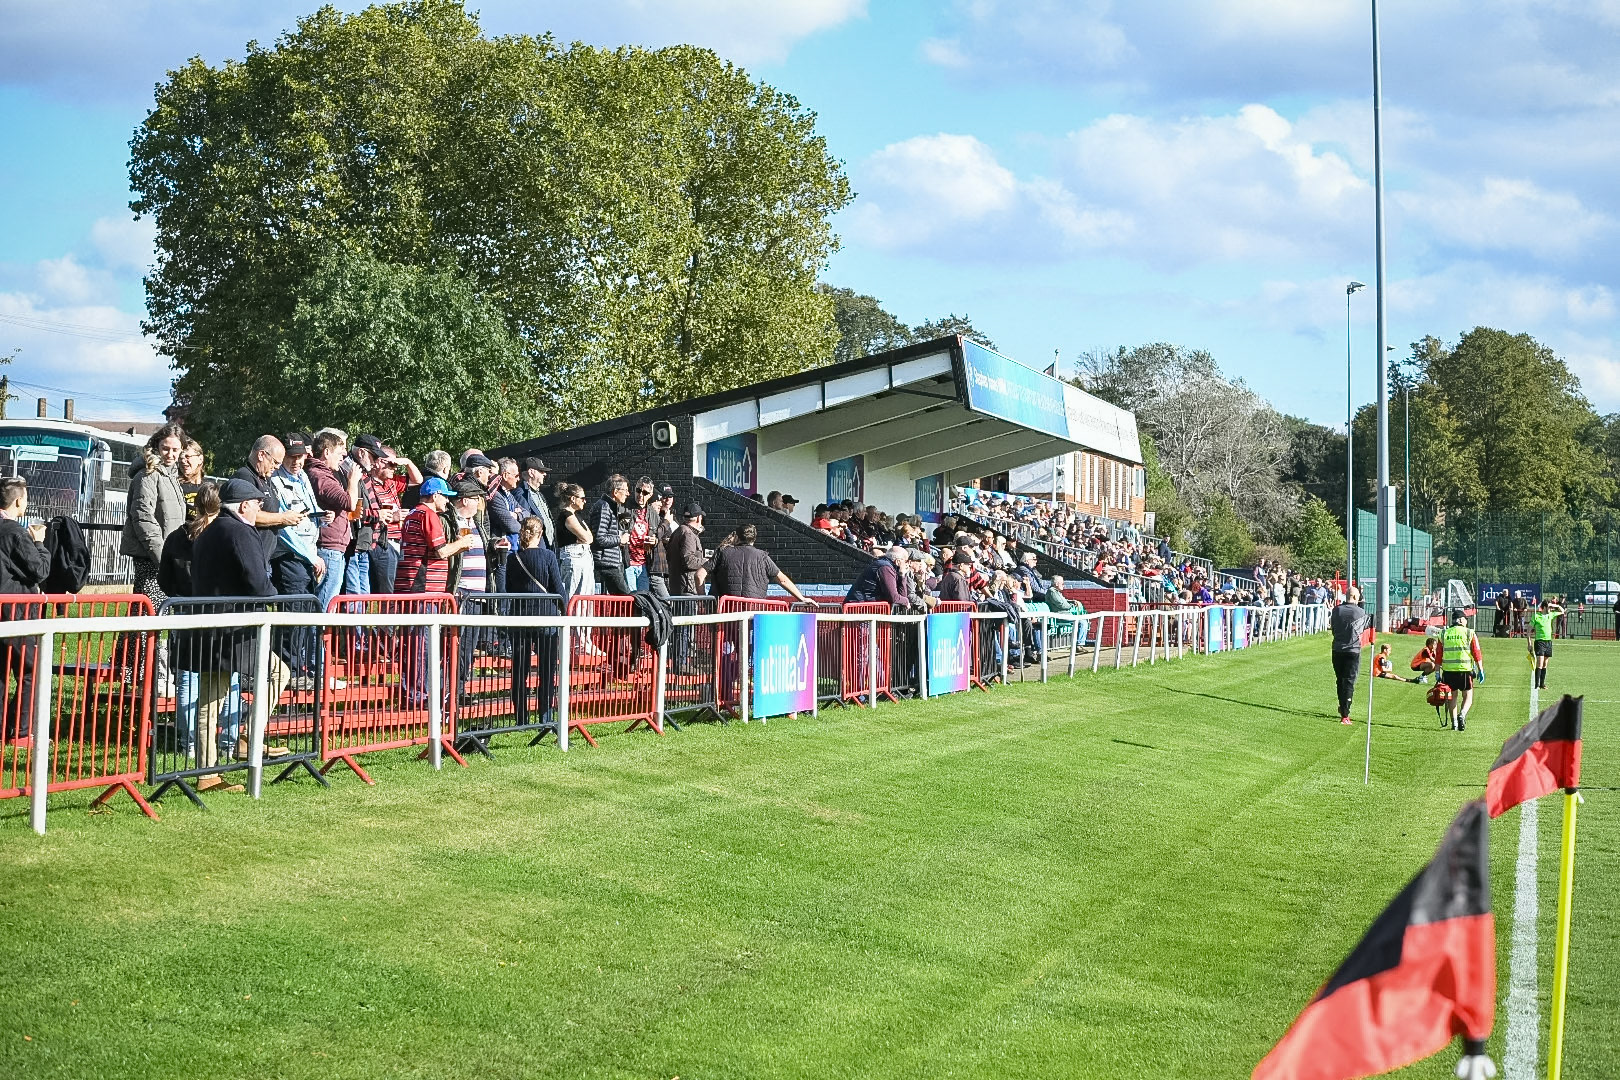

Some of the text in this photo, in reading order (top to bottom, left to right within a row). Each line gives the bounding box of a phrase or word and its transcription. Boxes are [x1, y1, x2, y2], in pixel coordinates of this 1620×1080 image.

[712, 449, 743, 488] utilita
[831, 469, 853, 501] utilita
[918, 483, 936, 513] utilita
[761, 644, 797, 696] utilita
[933, 637, 957, 678] utilita
